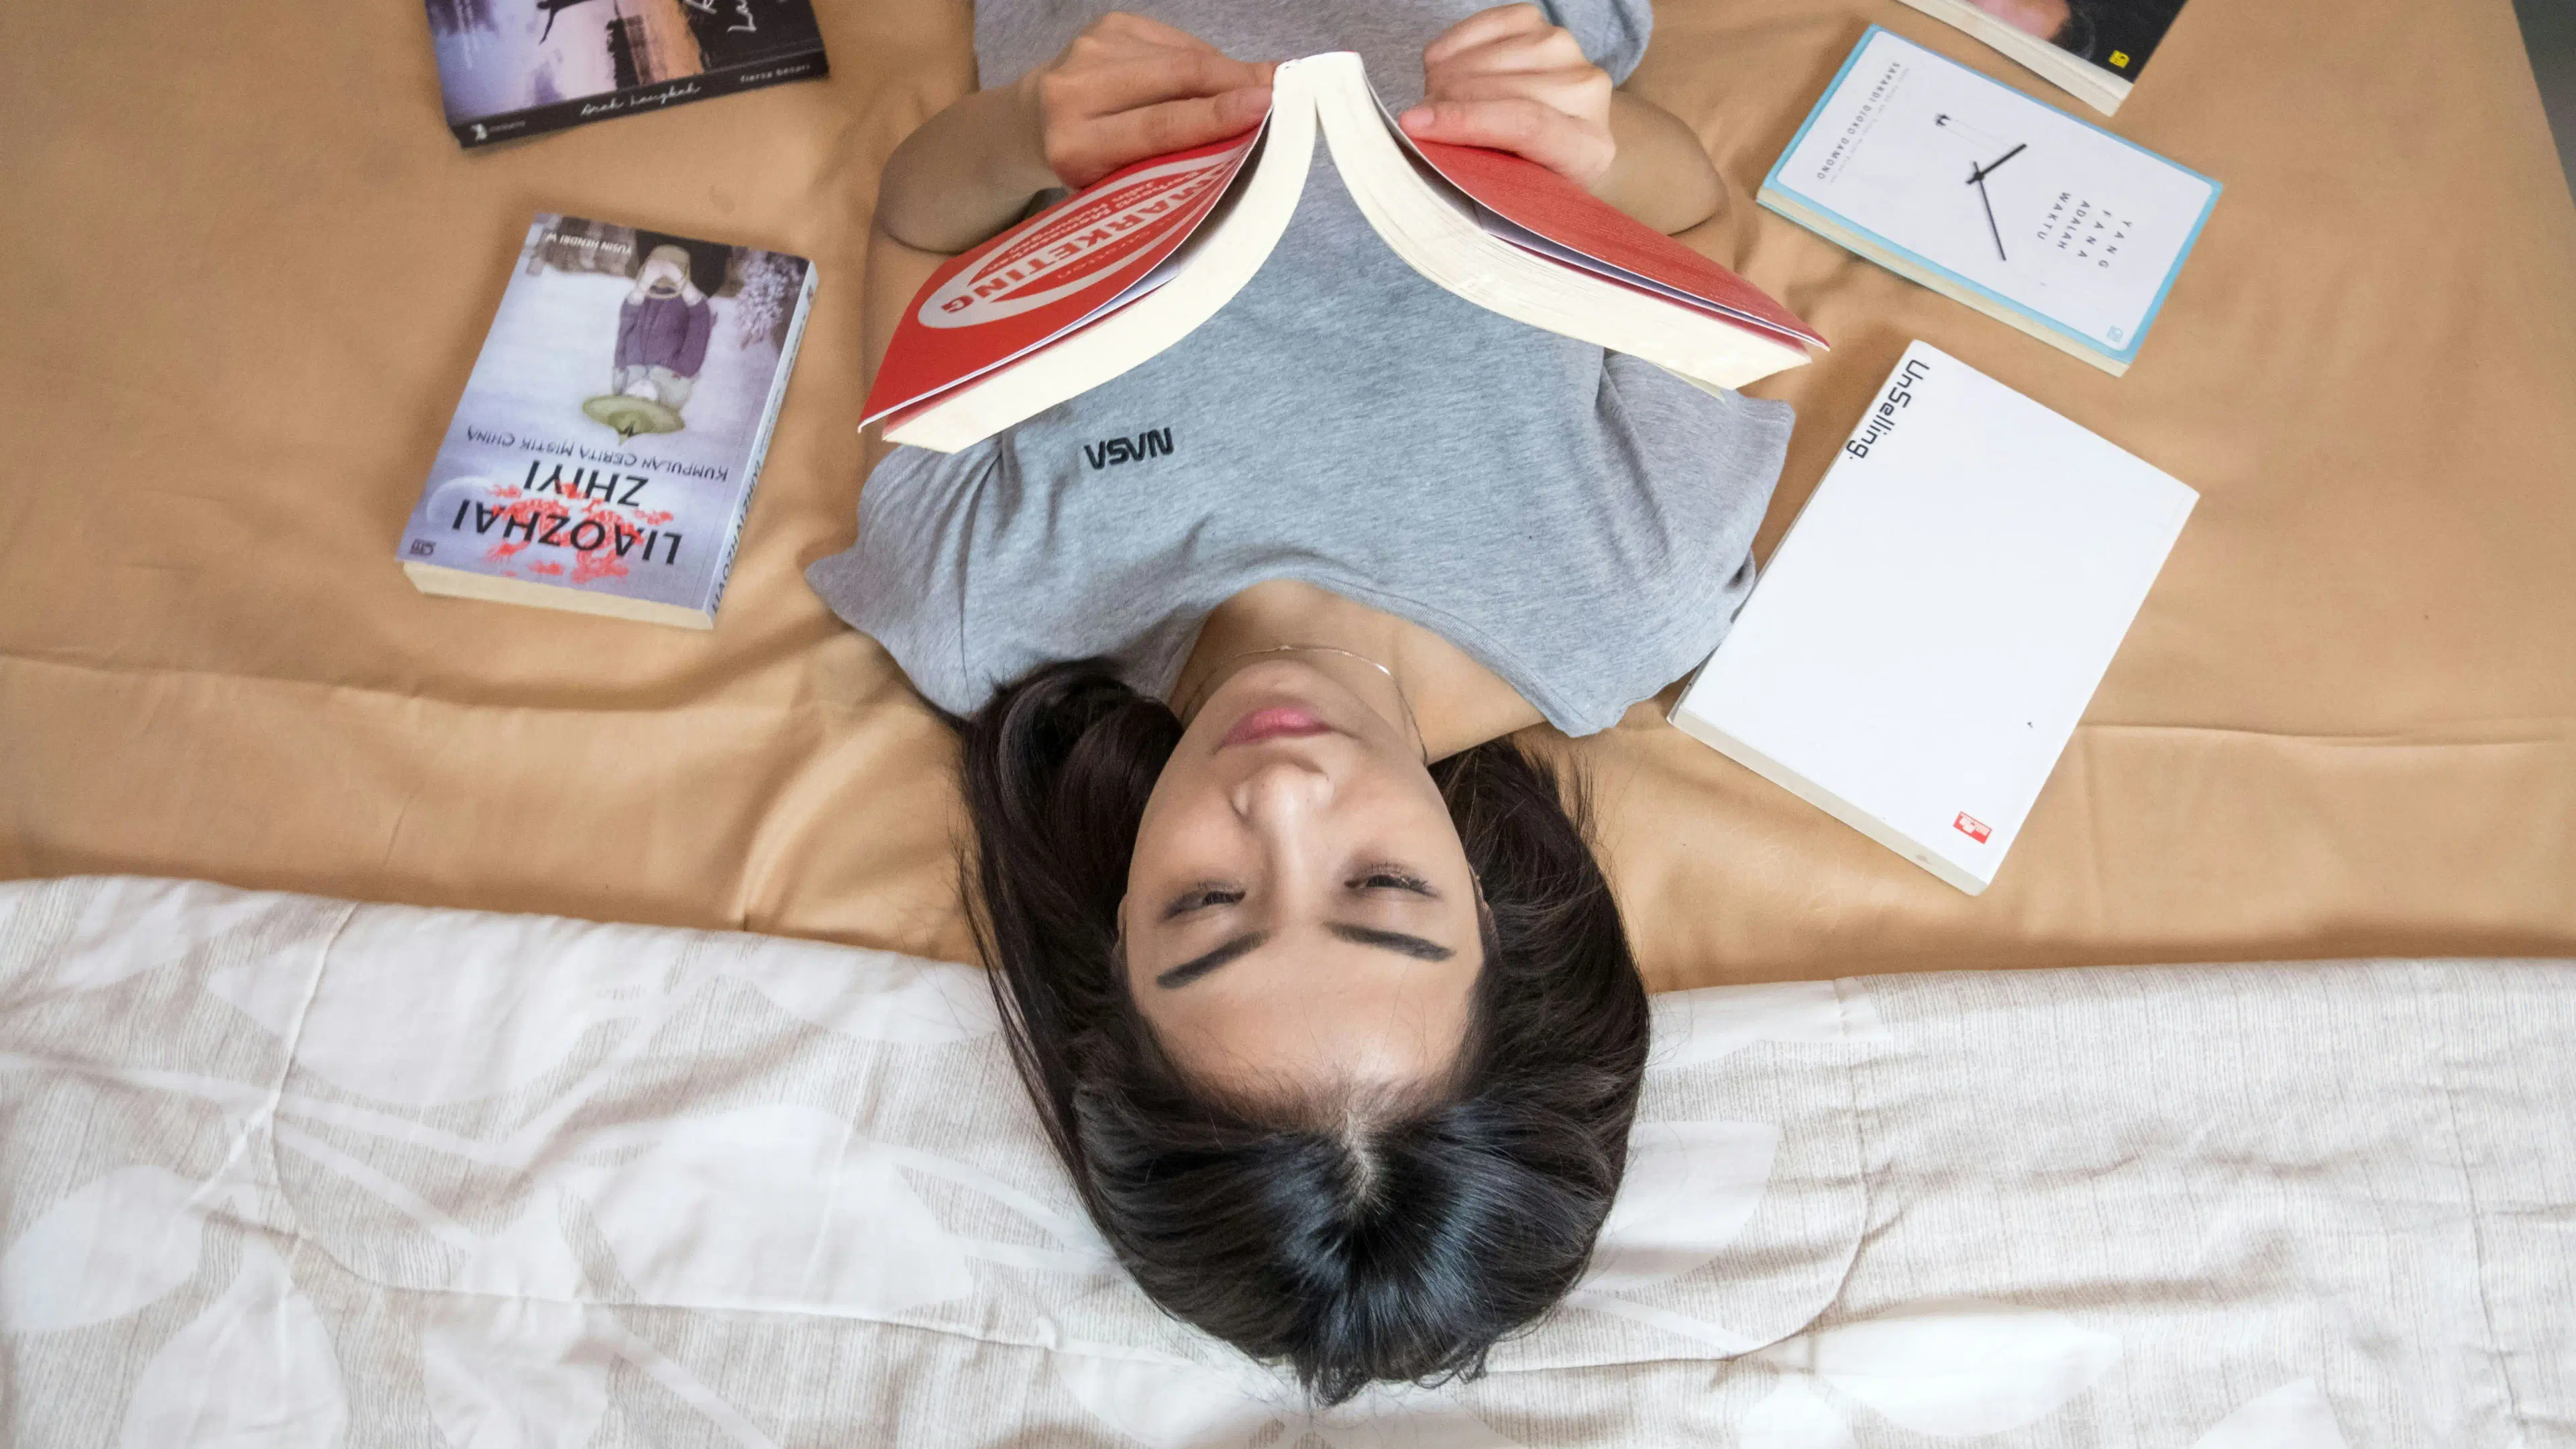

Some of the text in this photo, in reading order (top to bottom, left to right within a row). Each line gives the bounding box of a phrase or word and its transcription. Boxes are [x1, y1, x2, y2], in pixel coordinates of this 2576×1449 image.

[1868, 62, 1900, 102] SAPARDI
[1817, 137, 1850, 179] DAMONO
[2037, 192, 2072, 240] WAKTU
[2057, 199, 2091, 250] ADALAH
[2078, 209, 2112, 258] FANA
[559, 234, 600, 250] HENDRI
[600, 241, 632, 255] YUSIN
[2098, 219, 2133, 268] YANG
[1846, 360, 1930, 460] UnSelling.
[467, 424, 729, 482] KUMPULAN CERITA MISTIK CHINA
[1083, 427, 1174, 470] NASA
[523, 460, 649, 506] ZHIYI
[452, 499, 683, 566] LIAOZHAI
